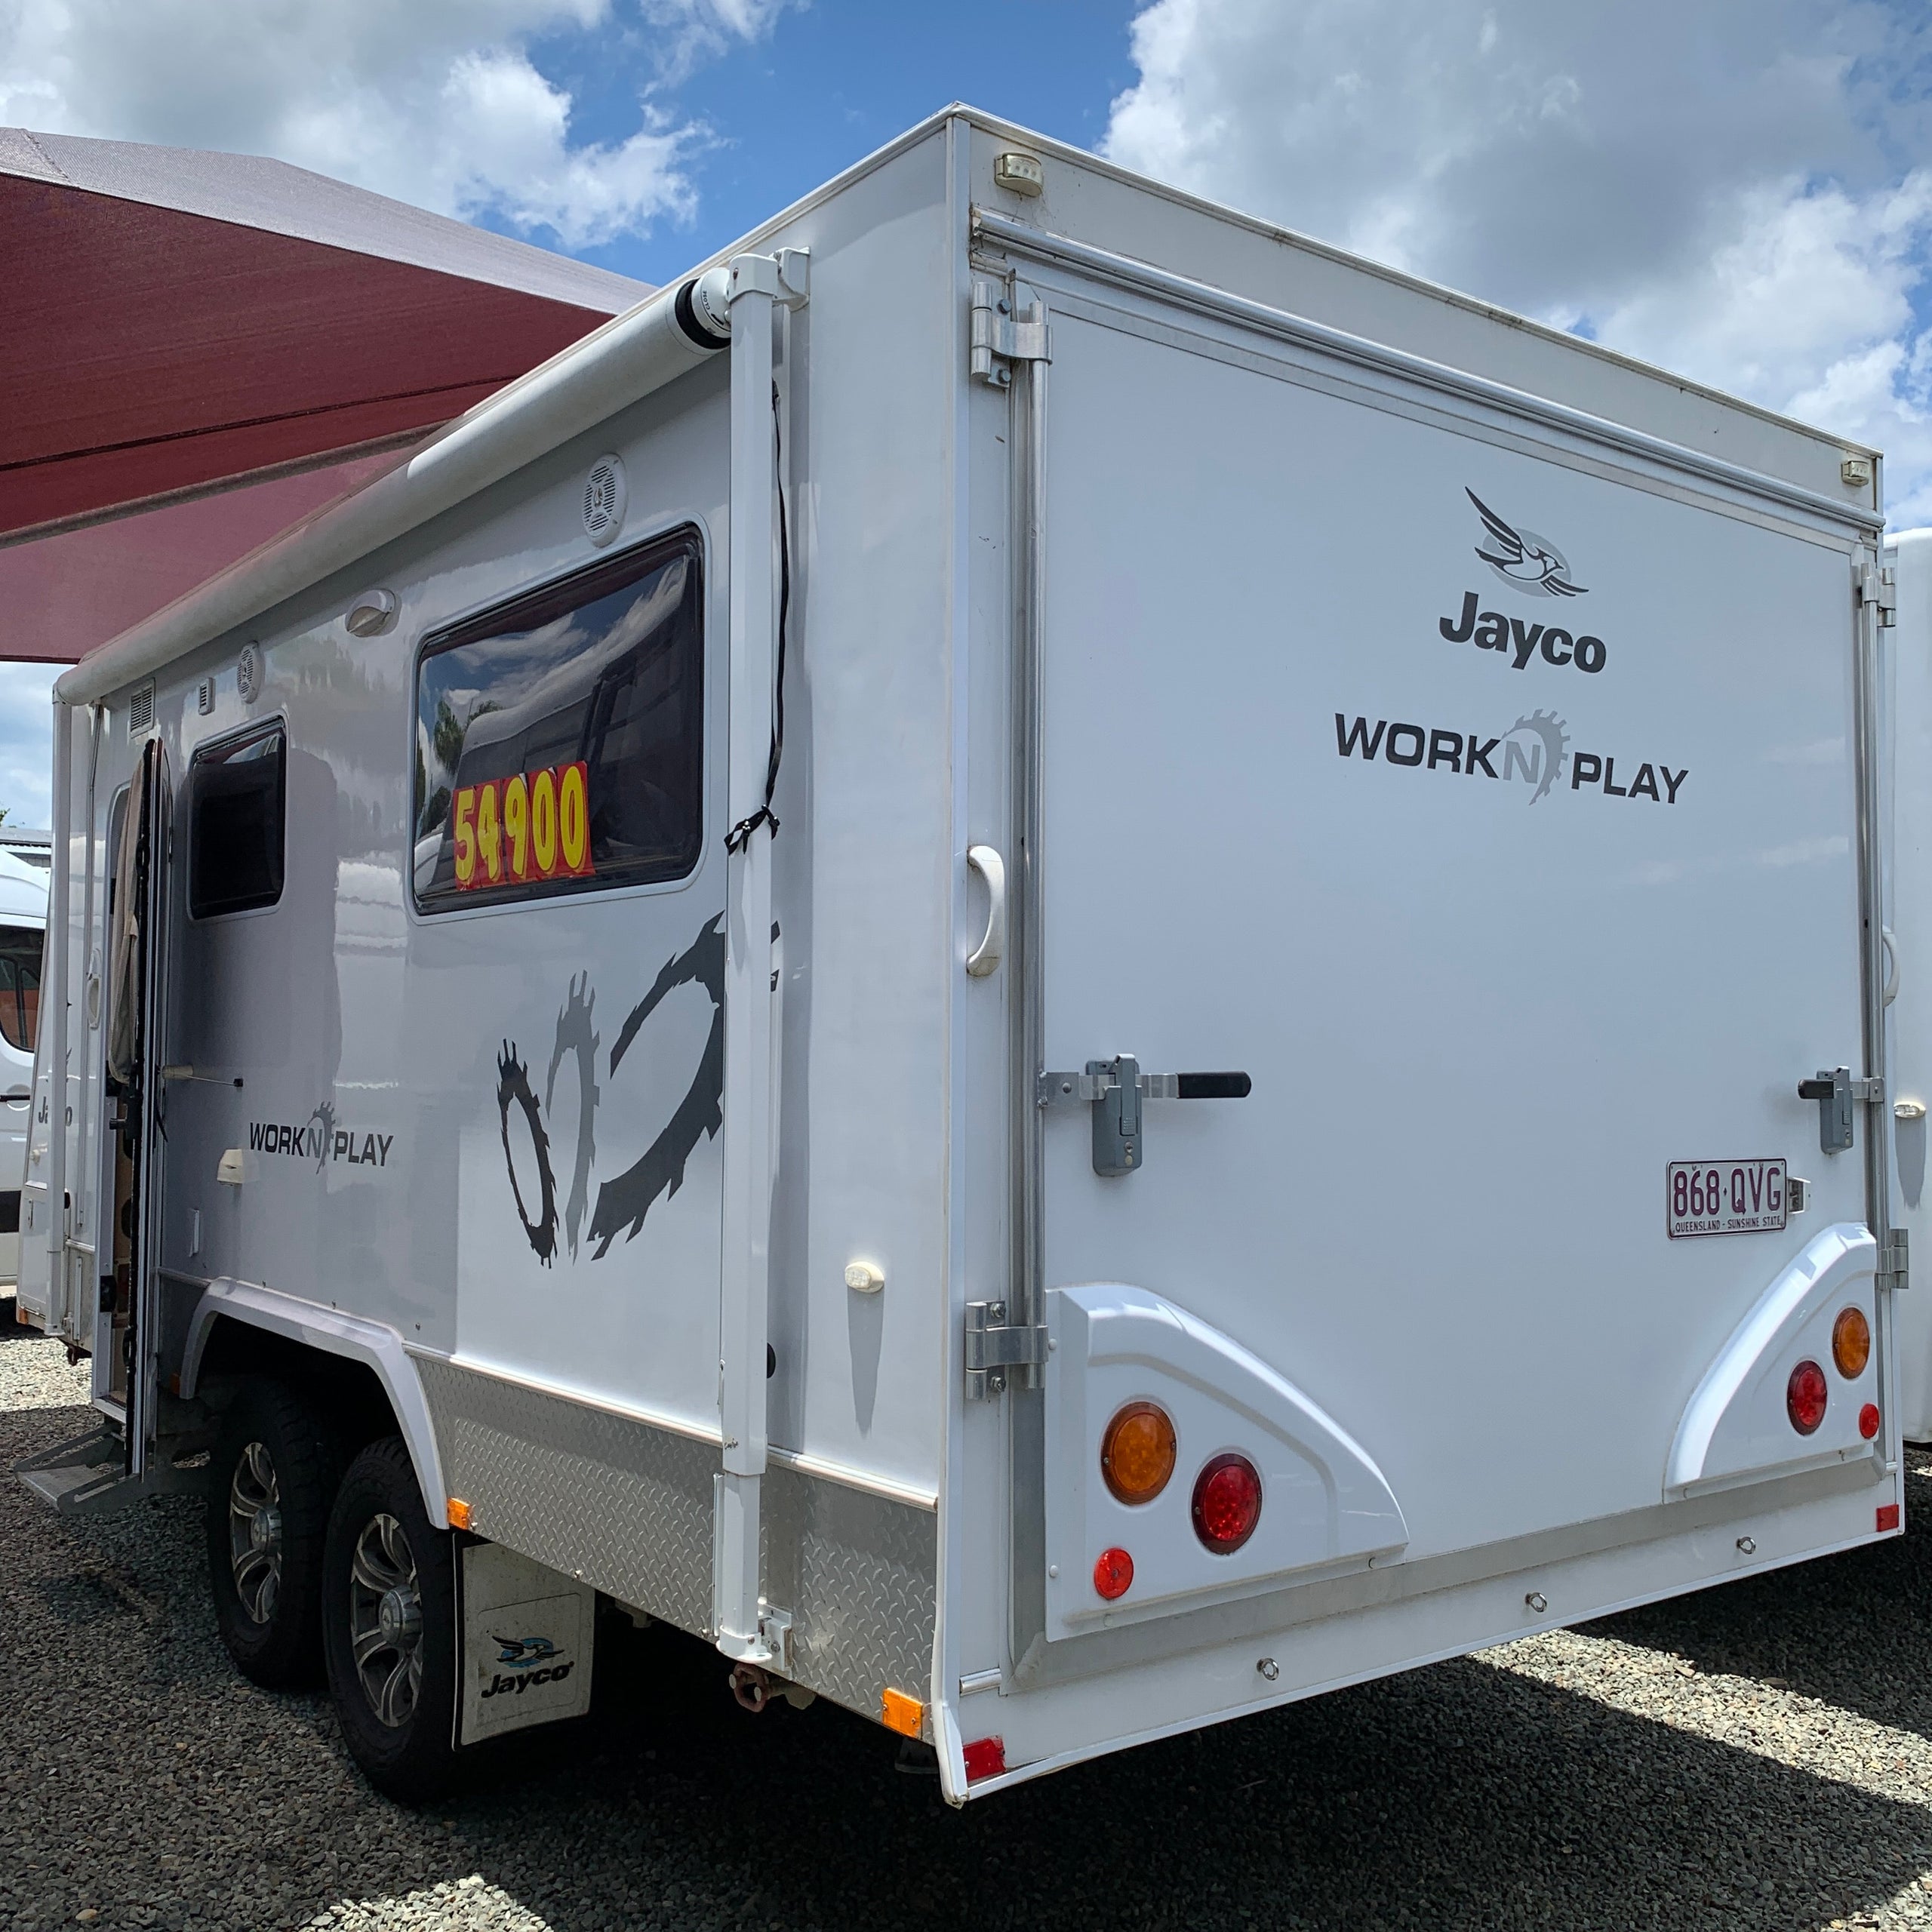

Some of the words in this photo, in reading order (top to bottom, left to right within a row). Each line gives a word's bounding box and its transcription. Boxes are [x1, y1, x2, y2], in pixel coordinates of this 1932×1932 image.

[703, 290, 711, 310] CLOSE
[1438, 591, 1607, 674] Jayco
[1571, 751, 1689, 804] PLAY
[455, 765, 586, 884] 54900
[333, 1130, 394, 1167] PLAY
[1675, 1220, 1721, 1232] QUEENSLAND
[1727, 1217, 1760, 1229] SUNSHINE
[1762, 1215, 1781, 1226] STATE
[481, 1663, 571, 1699] Jayco
